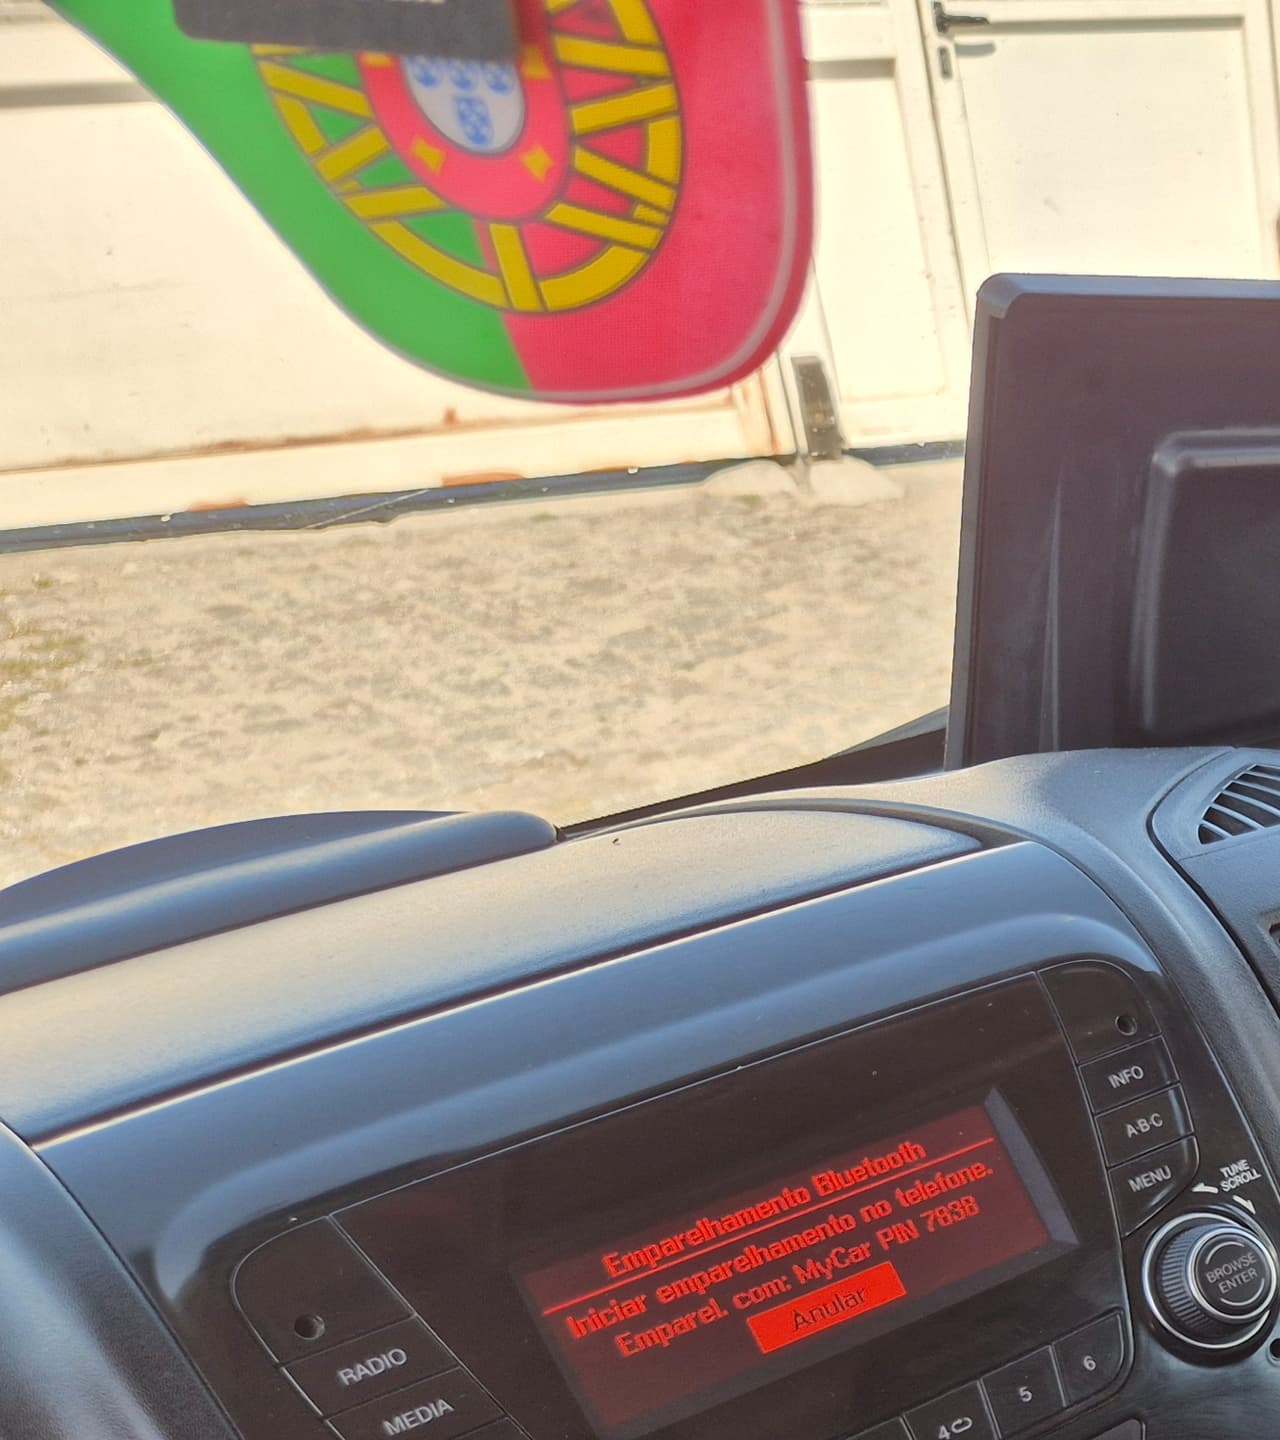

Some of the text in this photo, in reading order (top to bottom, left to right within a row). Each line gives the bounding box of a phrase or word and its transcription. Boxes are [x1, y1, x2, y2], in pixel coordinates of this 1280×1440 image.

[1108, 1065, 1144, 1089] INFO
[1128, 1166, 1172, 1192] MENU
[1220, 1160, 1250, 1178] TUNE
[1220, 1169, 1261, 1192] SCROLL
[602, 1141, 926, 1277] Emparelhamento Bluetooth
[567, 1162, 993, 1339] Iniciar emparelhamento no telefone.
[1206, 1253, 1257, 1284] BROWSE
[1218, 1268, 1258, 1294] ENTER
[615, 1298, 728, 1357] Emparel.
[733, 1275, 792, 1309] com:
[792, 1242, 871, 1284] MyCar
[875, 1219, 920, 1250] PIN
[792, 1288, 865, 1330] Anular
[337, 1348, 407, 1386] RADIO
[1083, 1355, 1096, 1371] 6
[1019, 1387, 1032, 1403] 5
[382, 1399, 454, 1436] MEDIA
[938, 1425, 951, 1440] 4
